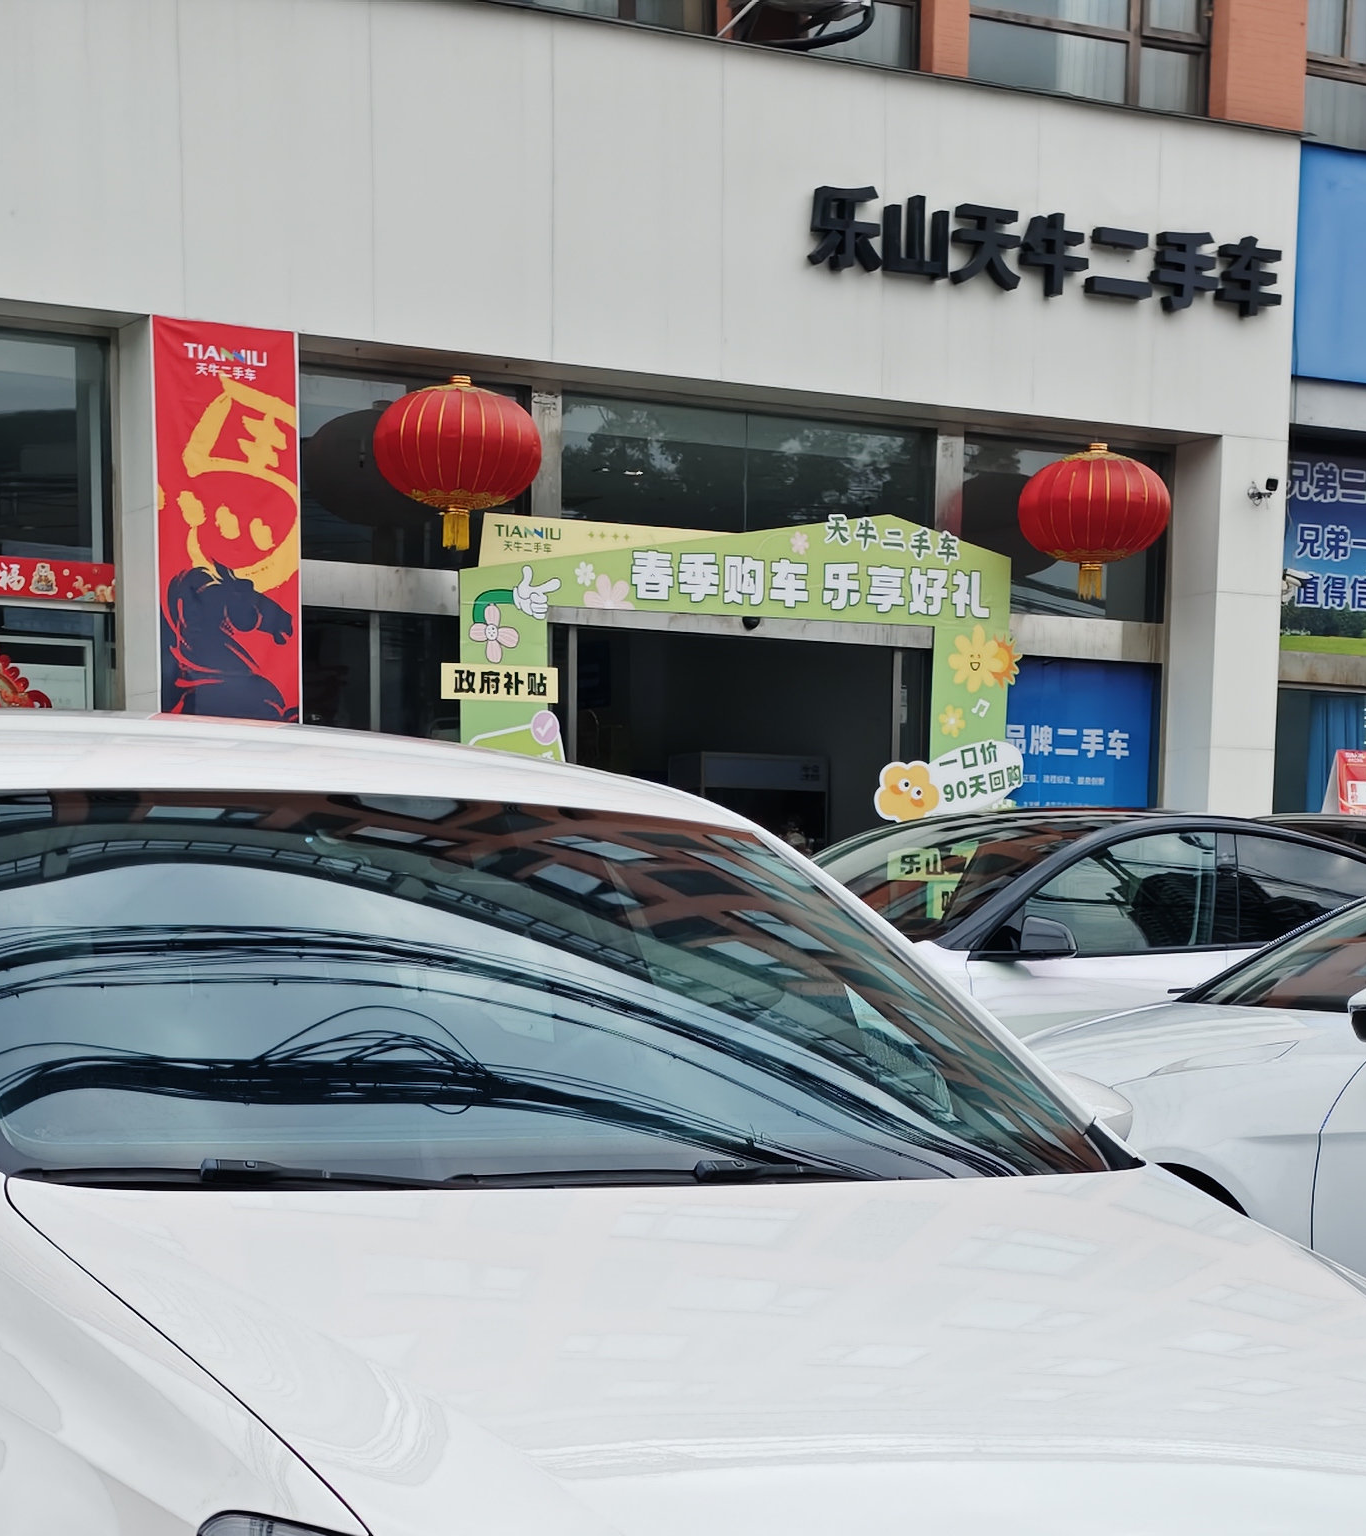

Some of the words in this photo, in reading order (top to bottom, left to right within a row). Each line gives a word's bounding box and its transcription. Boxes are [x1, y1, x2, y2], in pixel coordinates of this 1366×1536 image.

[808, 185, 1283, 317] 乐山天牛二手车
[183, 342, 267, 367] TIANNIU
[195, 362, 256, 381] 天牛二手车
[494, 524, 562, 541] TIANNIU
[503, 540, 552, 554] 天牛二手车
[825, 514, 960, 565] 天牛二手车
[631, 550, 809, 608] 春季购车
[823, 562, 992, 620] 乐享好礼
[453, 668, 549, 698] 政府补贴
[938, 741, 998, 771] 一口价
[1006, 723, 1130, 760] 品牌二手车
[943, 764, 1023, 803] 90天回购
